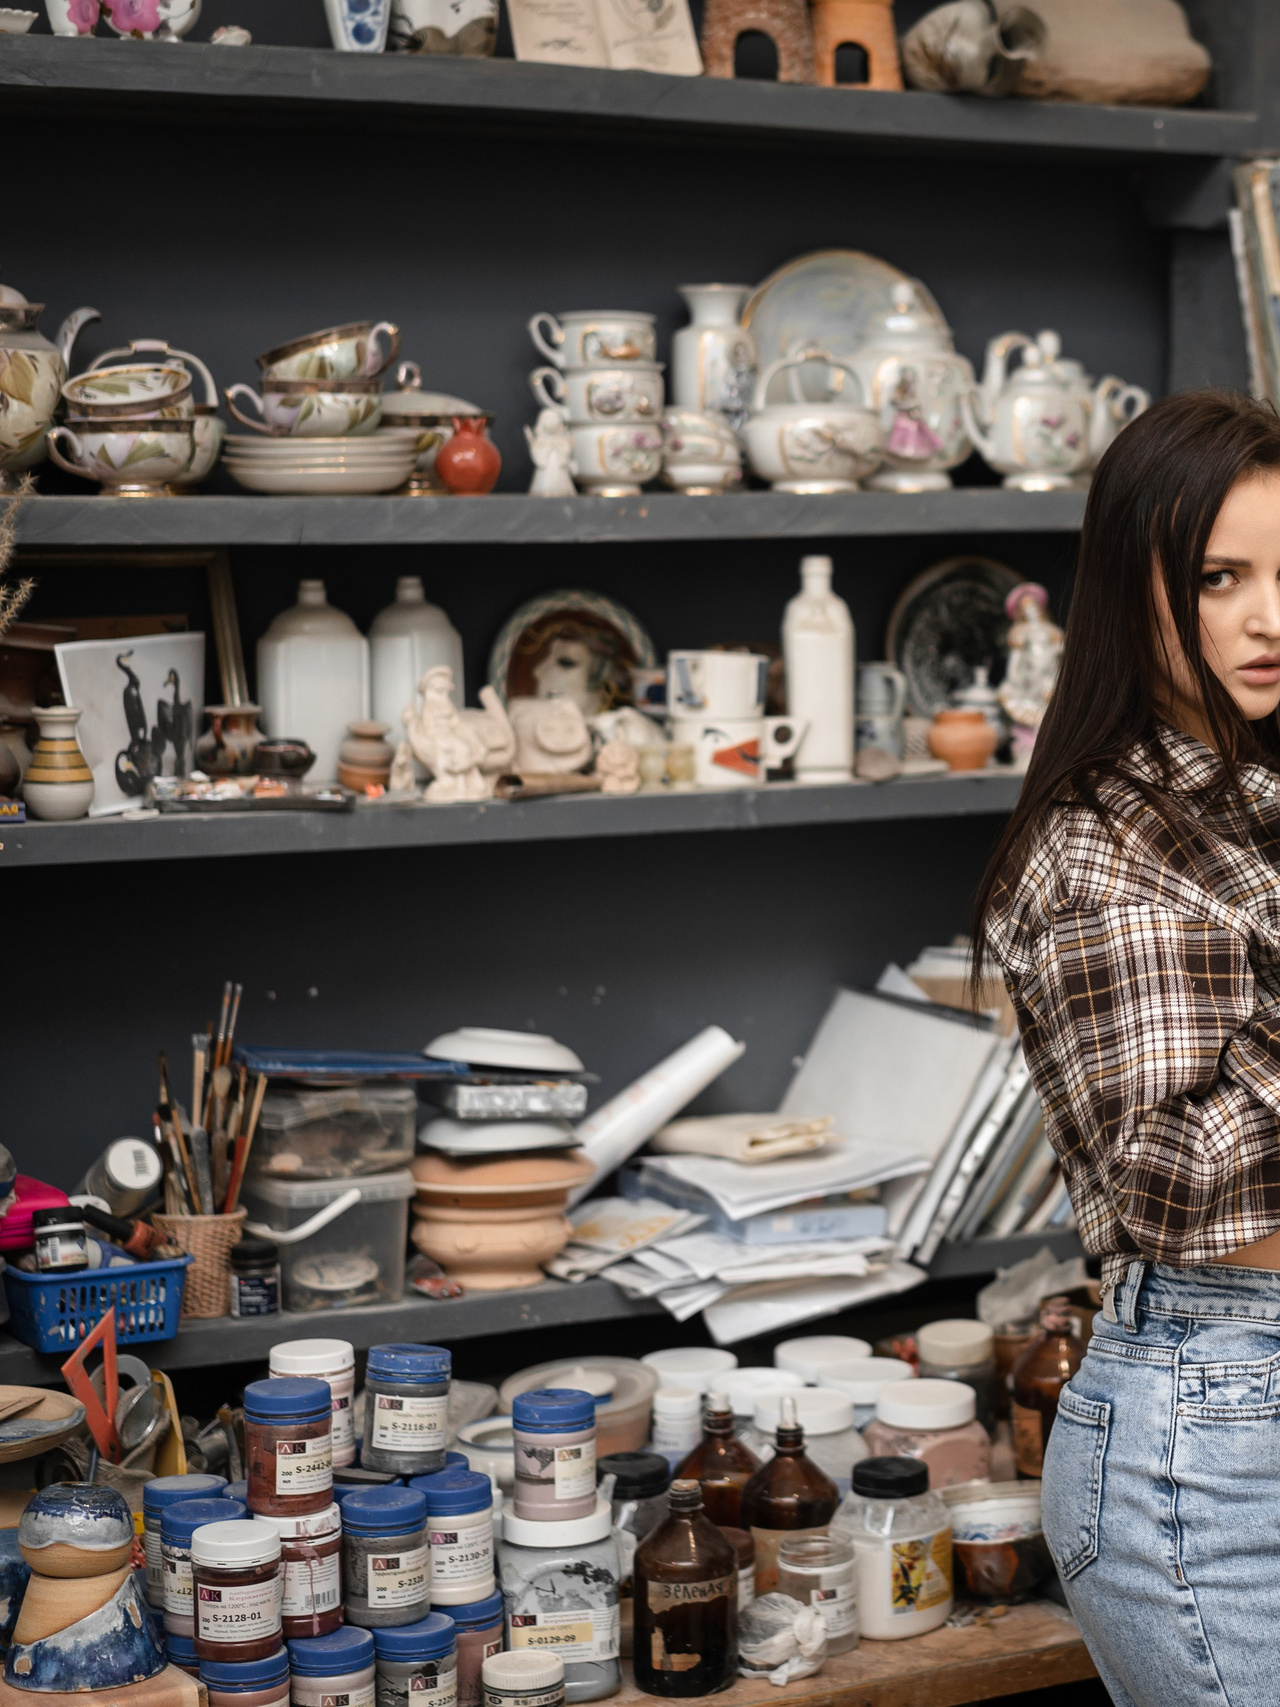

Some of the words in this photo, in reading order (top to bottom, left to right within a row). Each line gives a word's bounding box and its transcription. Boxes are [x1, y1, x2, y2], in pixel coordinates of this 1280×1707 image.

[391, 1422, 438, 1431] S-2116-03
[212, 1611, 262, 1623] S-2128-01
[527, 1634, 576, 1645] S-0129-09
